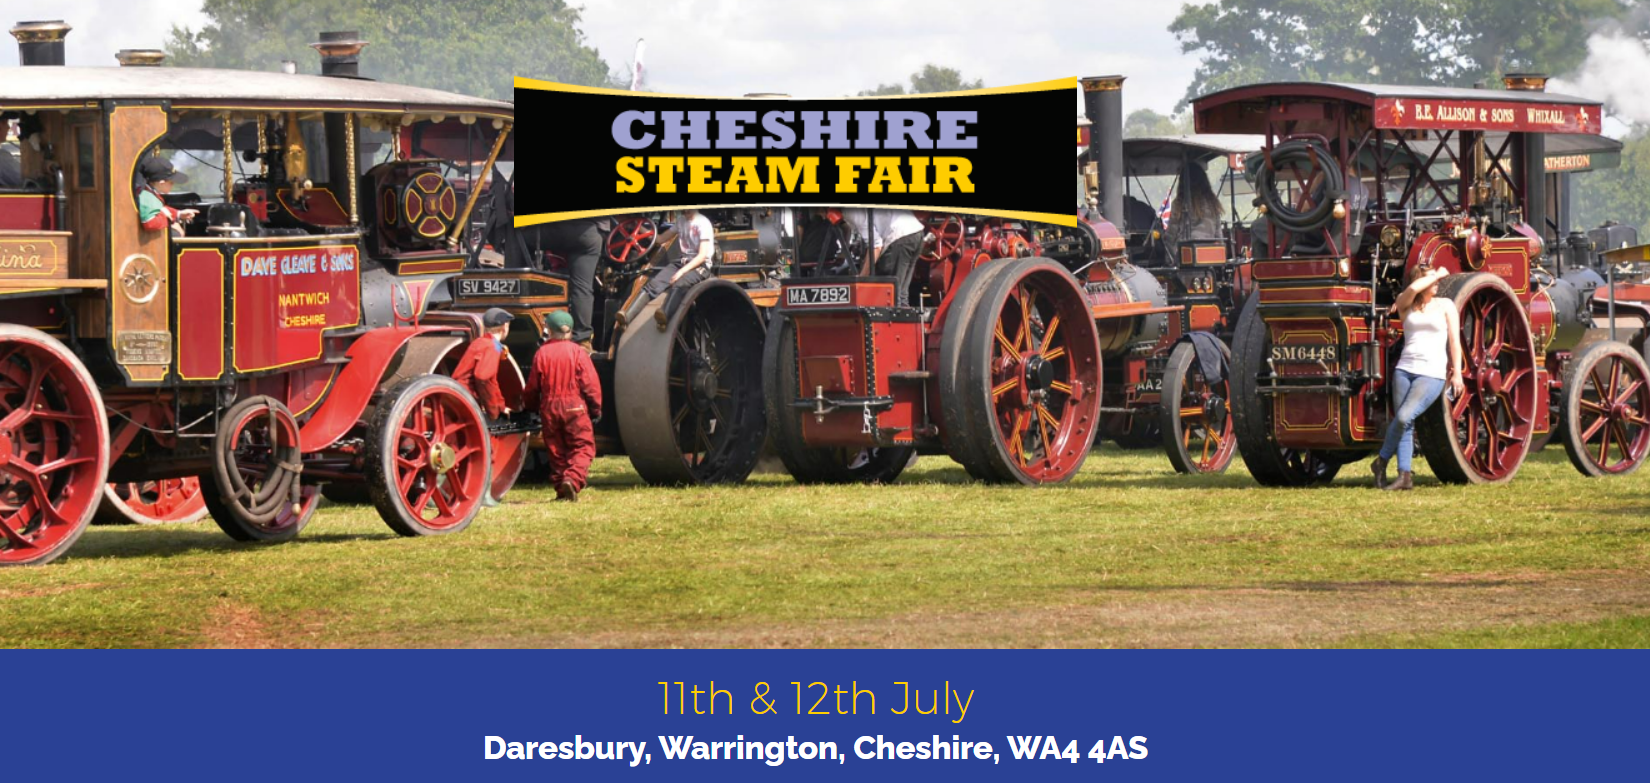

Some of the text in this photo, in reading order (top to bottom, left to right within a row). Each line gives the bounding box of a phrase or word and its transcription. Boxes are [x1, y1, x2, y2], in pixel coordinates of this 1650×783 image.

[1436, 105, 1476, 122] ALLISON
[1480, 108, 1488, 122] &
[1491, 108, 1515, 122] SONS
[1526, 108, 1566, 124] WHIXALL
[240, 256, 277, 276] DAVE
[280, 254, 316, 275] GLEAVE
[330, 252, 355, 272] SONS
[462, 281, 516, 293] SV 9427
[279, 293, 330, 307] NANTWICH
[790, 287, 848, 303] MA 7892
[284, 314, 327, 328] CHESHIRE
